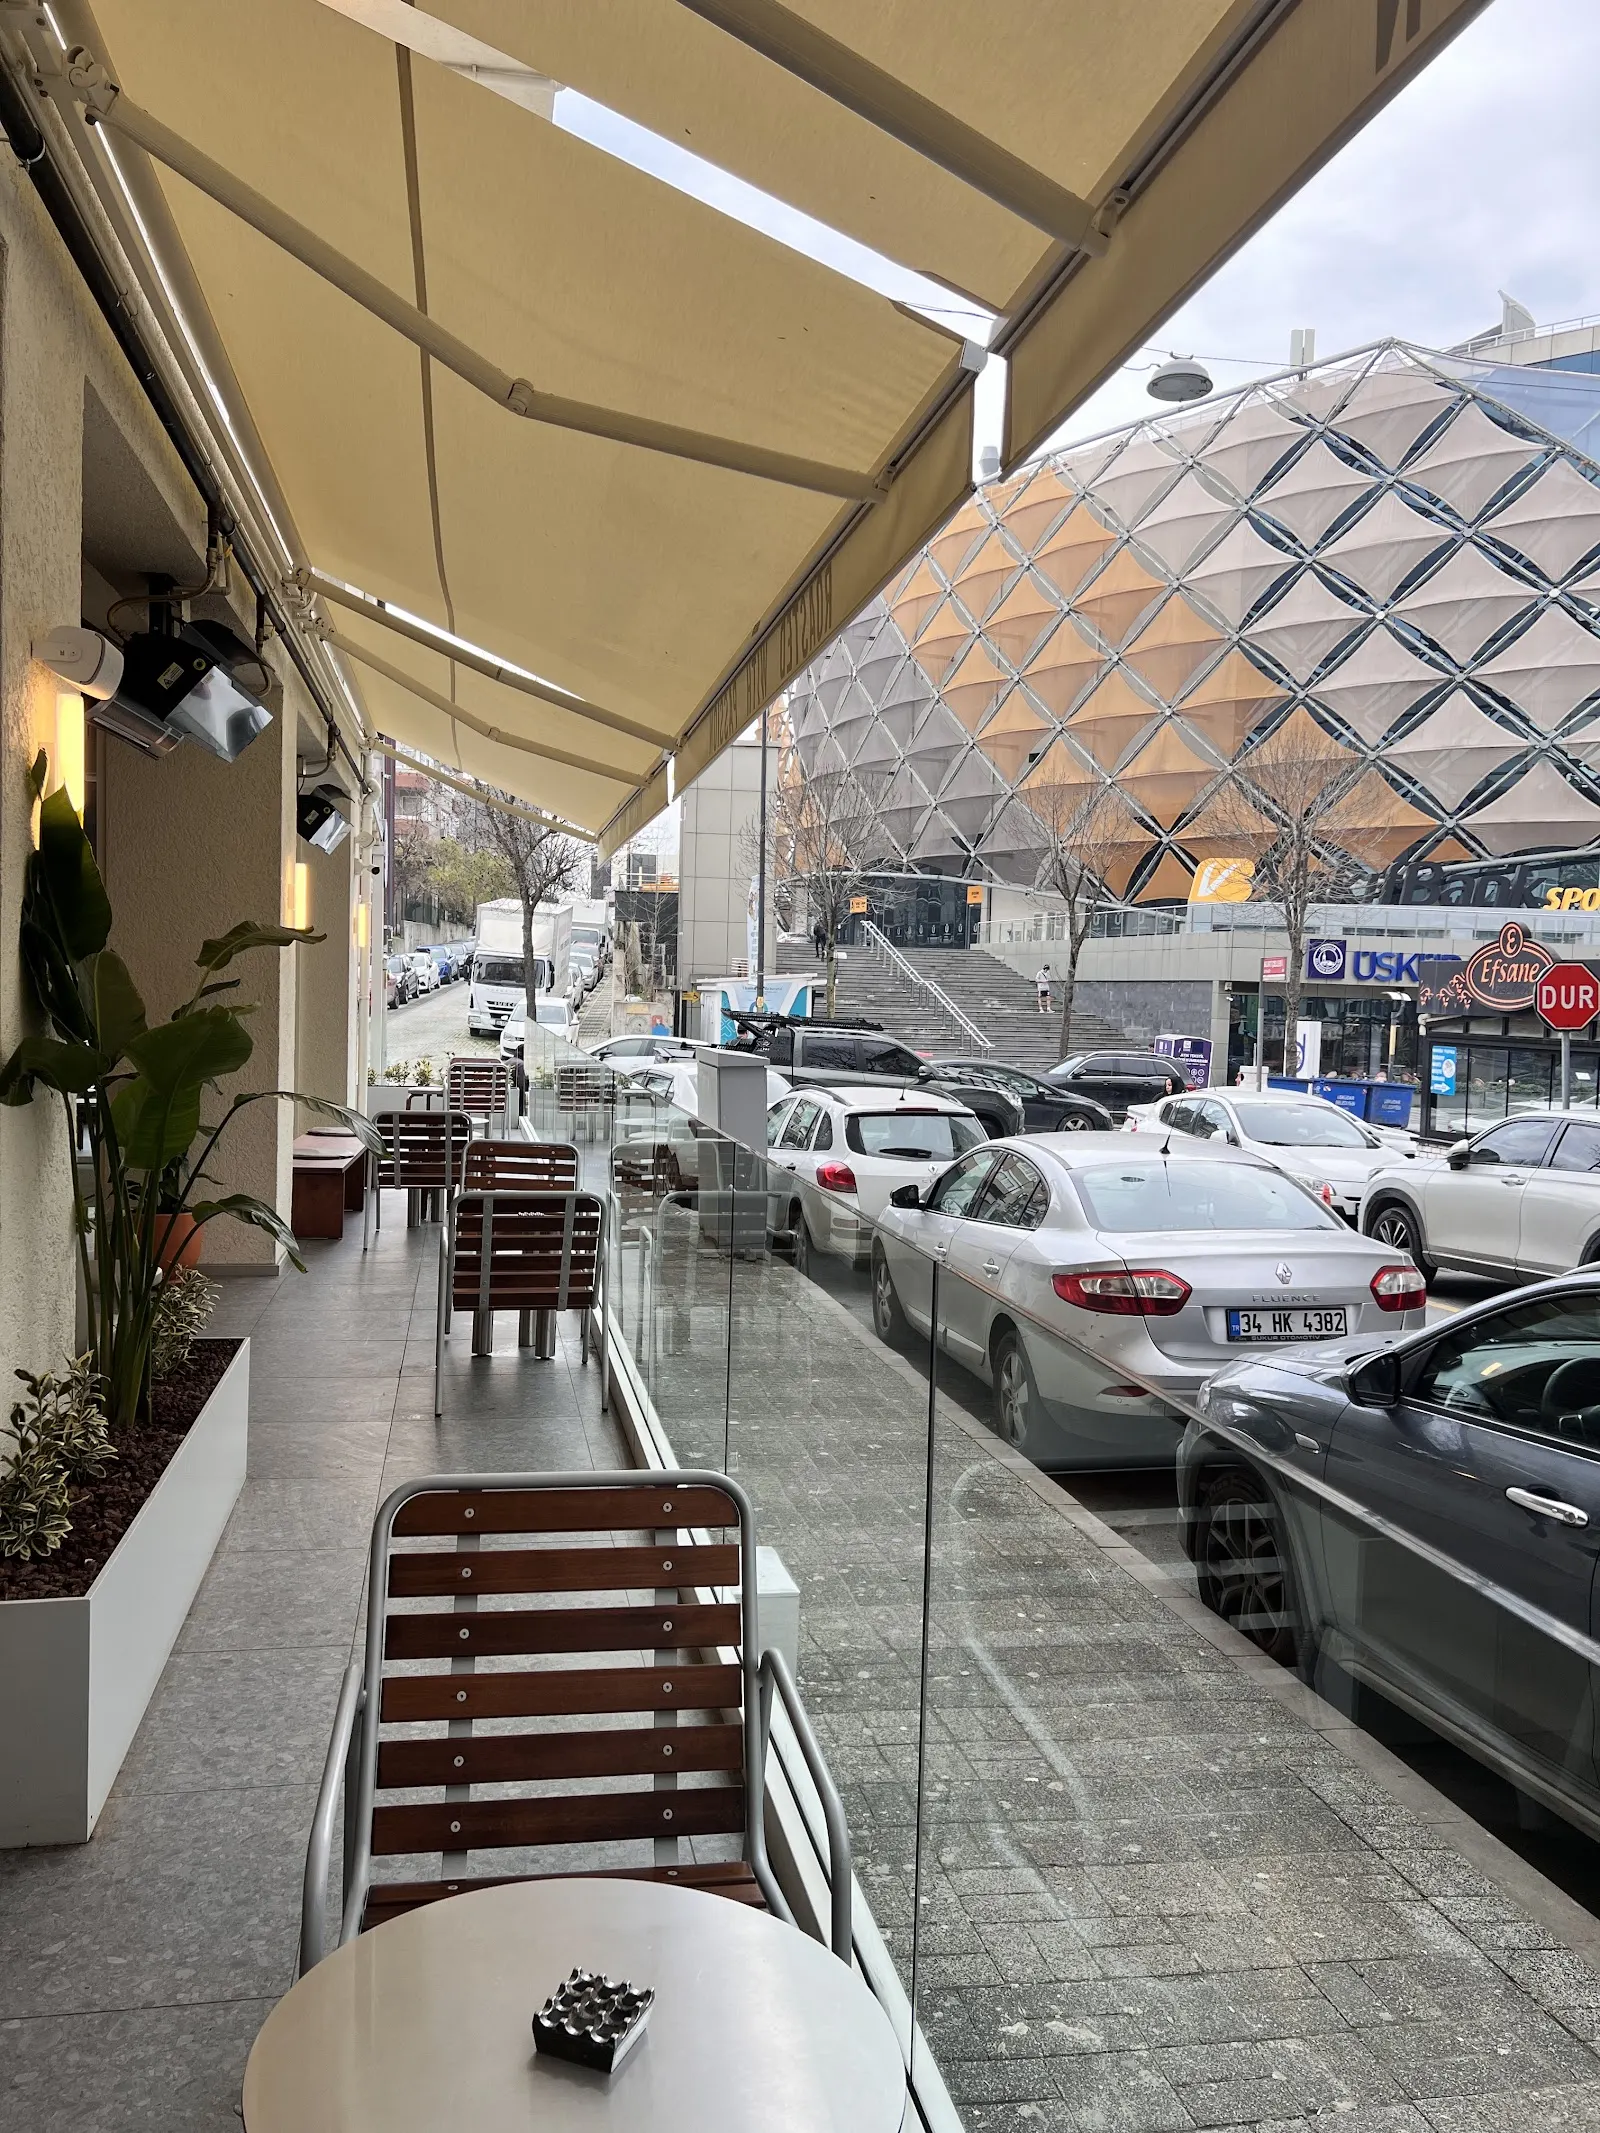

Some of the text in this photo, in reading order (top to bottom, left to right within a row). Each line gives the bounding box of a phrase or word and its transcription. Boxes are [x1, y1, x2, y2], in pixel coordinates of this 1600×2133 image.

[1481, 958, 1540, 988] Efsane
[1541, 985, 1595, 1009] DUR
[1252, 1294, 1320, 1303] FLUENCE
[1241, 1313, 1262, 1333] 34
[1272, 1312, 1293, 1333] HK
[1303, 1312, 1344, 1332] 4382
